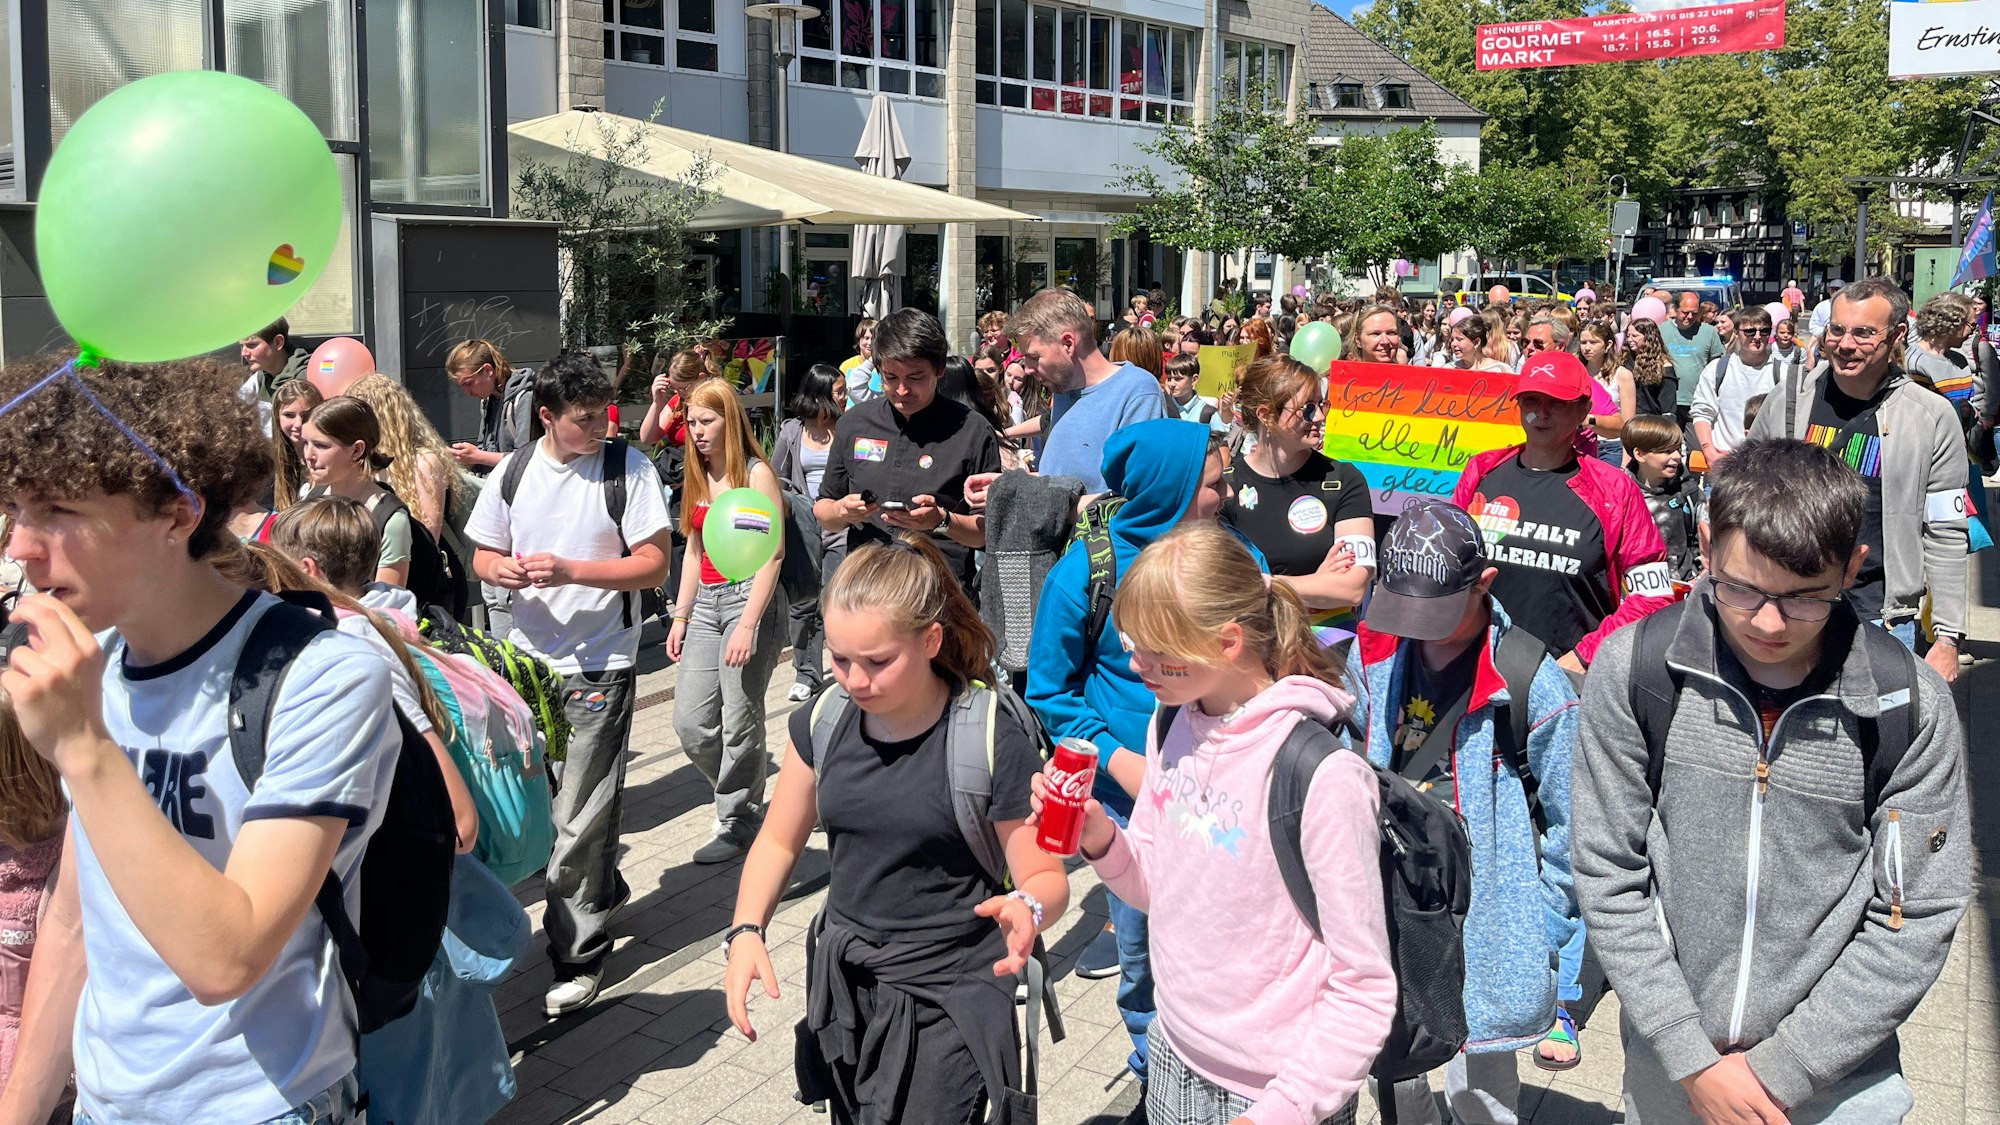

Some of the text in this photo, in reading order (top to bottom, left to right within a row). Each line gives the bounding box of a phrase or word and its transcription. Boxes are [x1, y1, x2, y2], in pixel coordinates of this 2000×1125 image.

[1593, 8, 1733, 27] MARKTPLATZ 16 BIS 22 UHR
[1484, 24, 1542, 35] HENNEFER
[1602, 25, 1720, 41] 11.4. 16.5. 20.6.
[1481, 31, 1585, 50] GOURMET
[1602, 36, 1720, 52] 18.7. 15.8. 12.9.
[1917, 25, 2000, 54] Ernstin
[1482, 49, 1555, 66] MARKT
[1342, 379, 1513, 419] Gott liebt
[1358, 419, 1424, 460] alle
[1379, 467, 1455, 503] gleic
[1482, 501, 1509, 517] FÜR
[1482, 530, 1499, 544] ND
[1340, 540, 1376, 560] RDN
[1484, 543, 1581, 576] OLERANZ
[1161, 663, 1189, 677] LOVE
